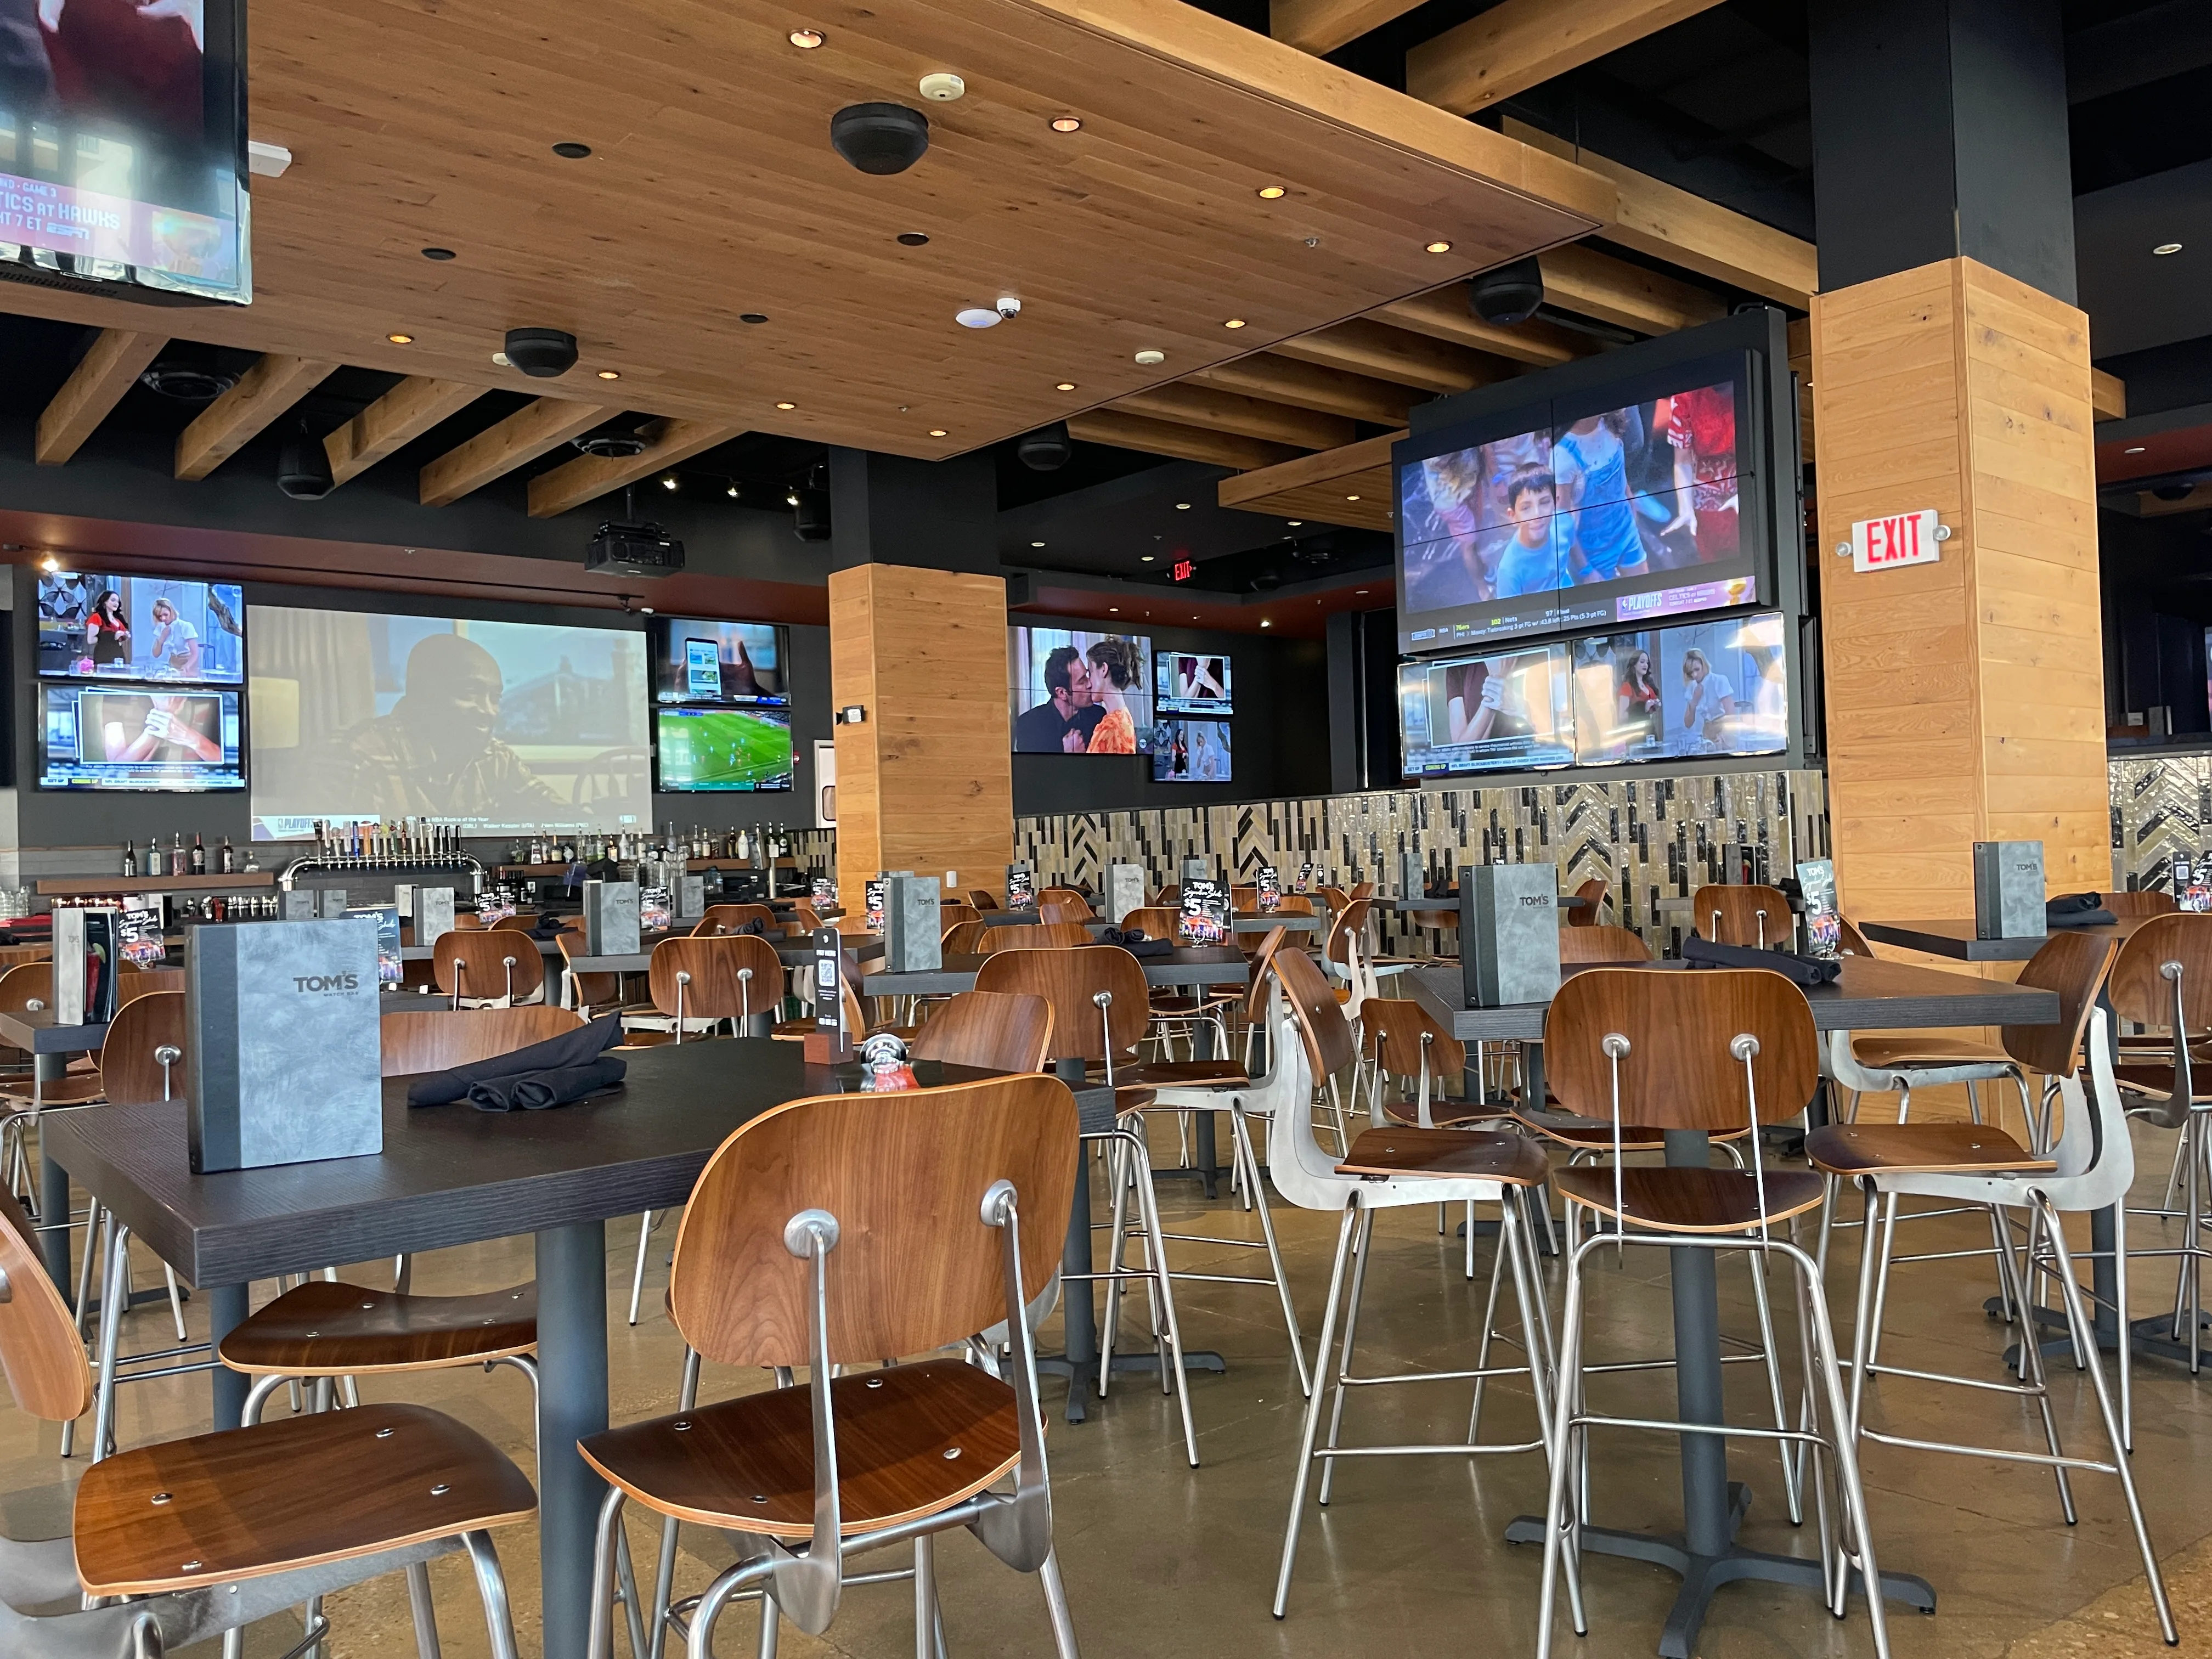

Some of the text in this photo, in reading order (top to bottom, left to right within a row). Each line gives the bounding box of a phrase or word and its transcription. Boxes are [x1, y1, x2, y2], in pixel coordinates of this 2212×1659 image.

[22, 182, 49, 196] GAME
[50, 188, 57, 198] 3
[37, 203, 54, 217] AT
[58, 203, 120, 230] HAWKS
[15, 214, 23, 227] 7
[27, 216, 42, 230] ET
[47, 222, 89, 240] ESPN
[1867, 514, 1921, 563] EXIT
[1175, 561, 1190, 580] EXIT
[1629, 592, 1662, 611] PLAYOFFS
[1807, 864, 1825, 876] TOM'S
[2192, 868, 2208, 885] $5
[1010, 884, 1020, 894] $5
[1193, 882, 1215, 890] TOM'S
[1260, 879, 1270, 891] $5
[642, 899, 654, 911] $5
[868, 896, 883, 910] $5
[917, 898, 935, 906] TOM'S
[1184, 898, 1201, 916] $5
[1519, 894, 1549, 906] TOM'S
[1807, 891, 1822, 915] $5
[126, 910, 149, 919] TOM'S
[120, 927, 139, 943] $5
[293, 970, 359, 992] TOM'S
